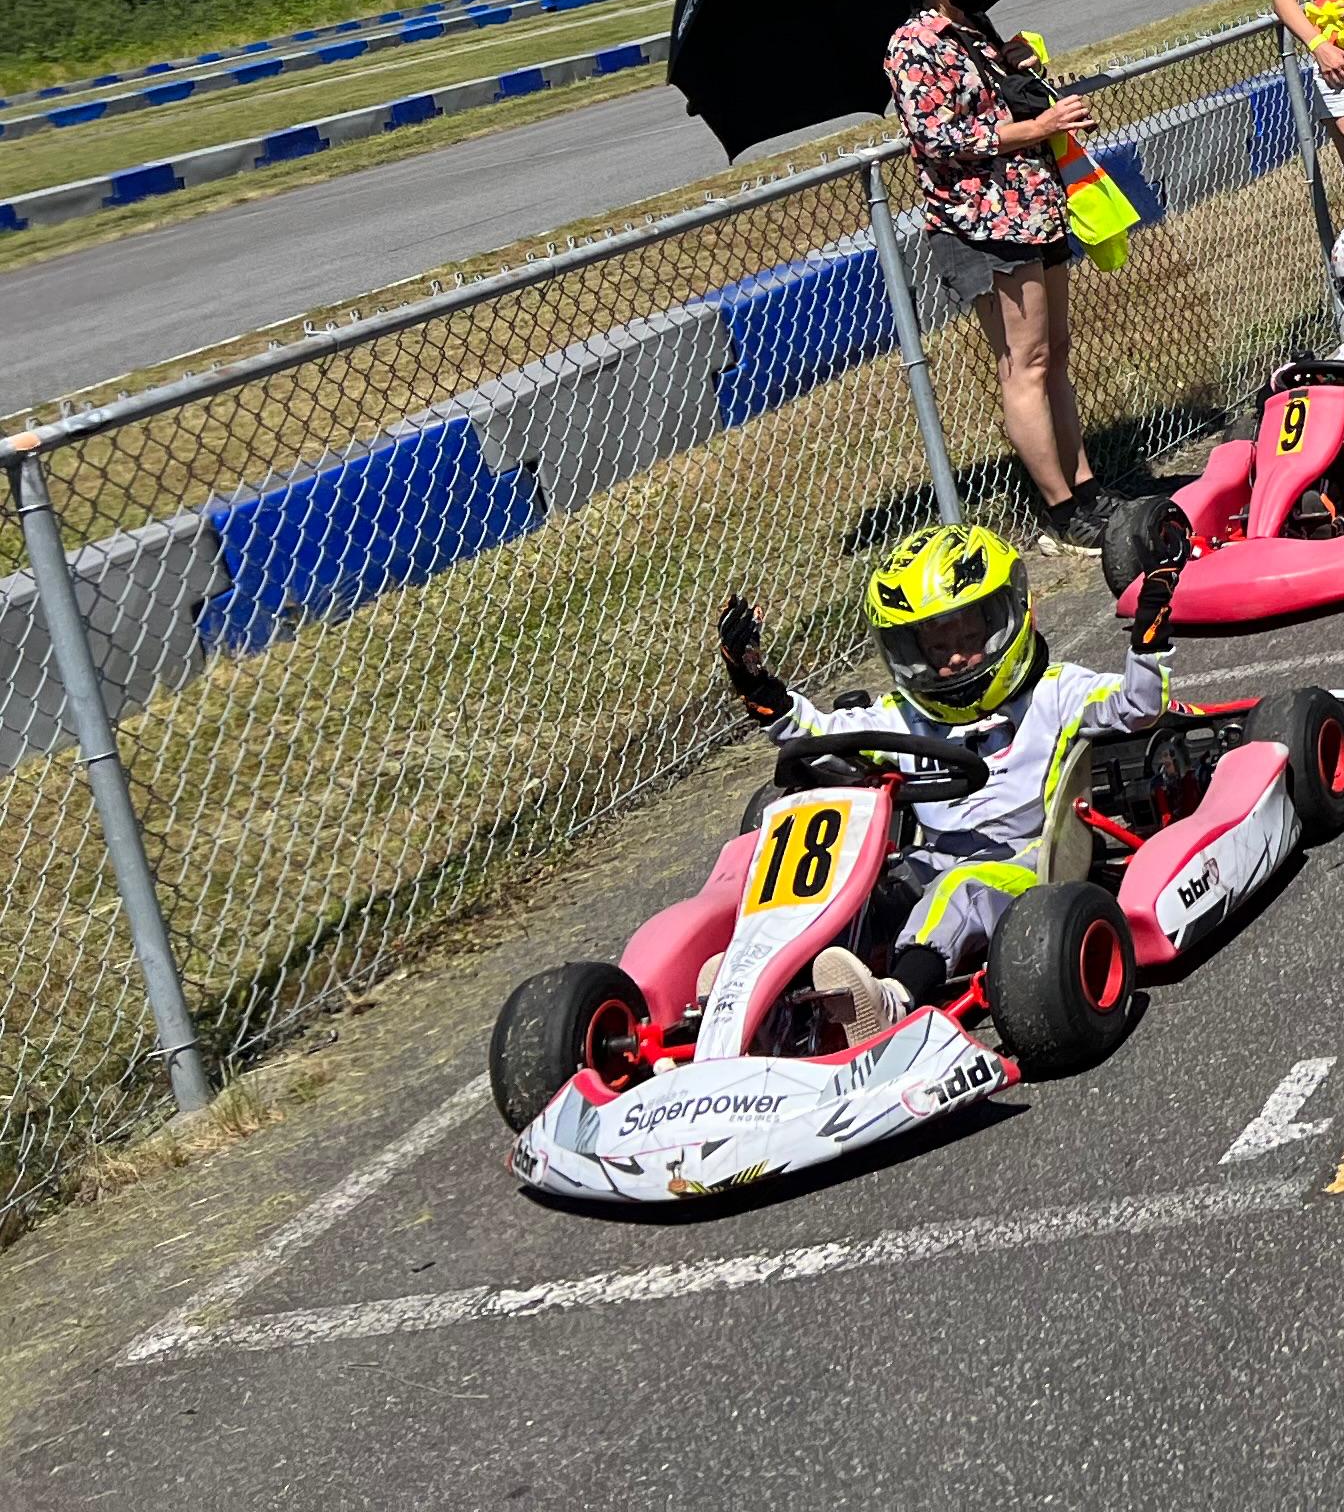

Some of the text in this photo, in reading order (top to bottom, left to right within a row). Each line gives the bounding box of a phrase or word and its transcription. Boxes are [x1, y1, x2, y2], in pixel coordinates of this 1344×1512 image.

[1280, 399, 1307, 452] 9
[758, 808, 842, 905] 18
[1177, 870, 1212, 910] bbr
[618, 1094, 788, 1137] Superpower
